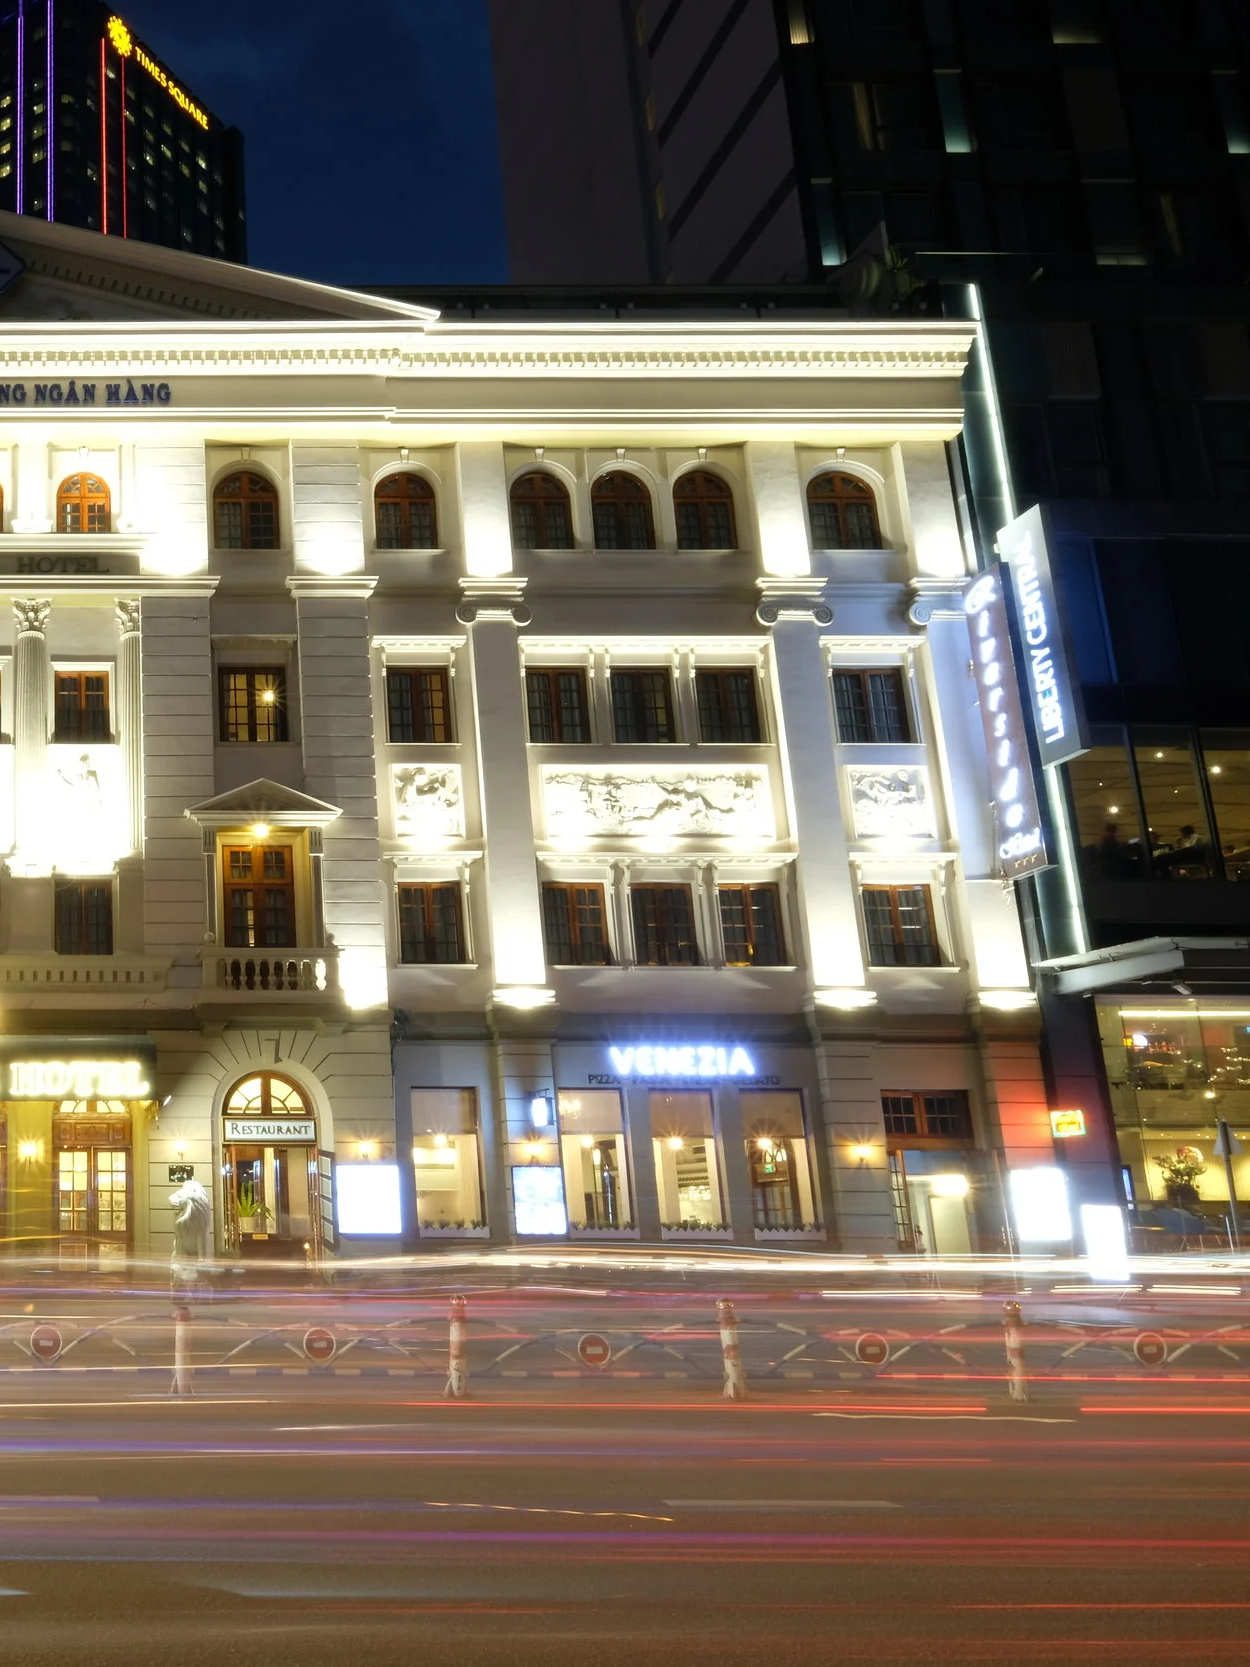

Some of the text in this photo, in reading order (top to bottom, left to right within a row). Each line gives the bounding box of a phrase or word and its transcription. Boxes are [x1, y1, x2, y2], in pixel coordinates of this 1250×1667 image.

[135, 46, 208, 130] TIMES SQUARE
[34, 379, 96, 404] NGÂN
[105, 378, 171, 404] HÀNG
[16, 556, 110, 574] HOTEL
[1017, 530, 1065, 744] LIBERTY CENTRAL
[609, 1046, 756, 1076] VENEZIA
[9, 1062, 150, 1097] HOTEL
